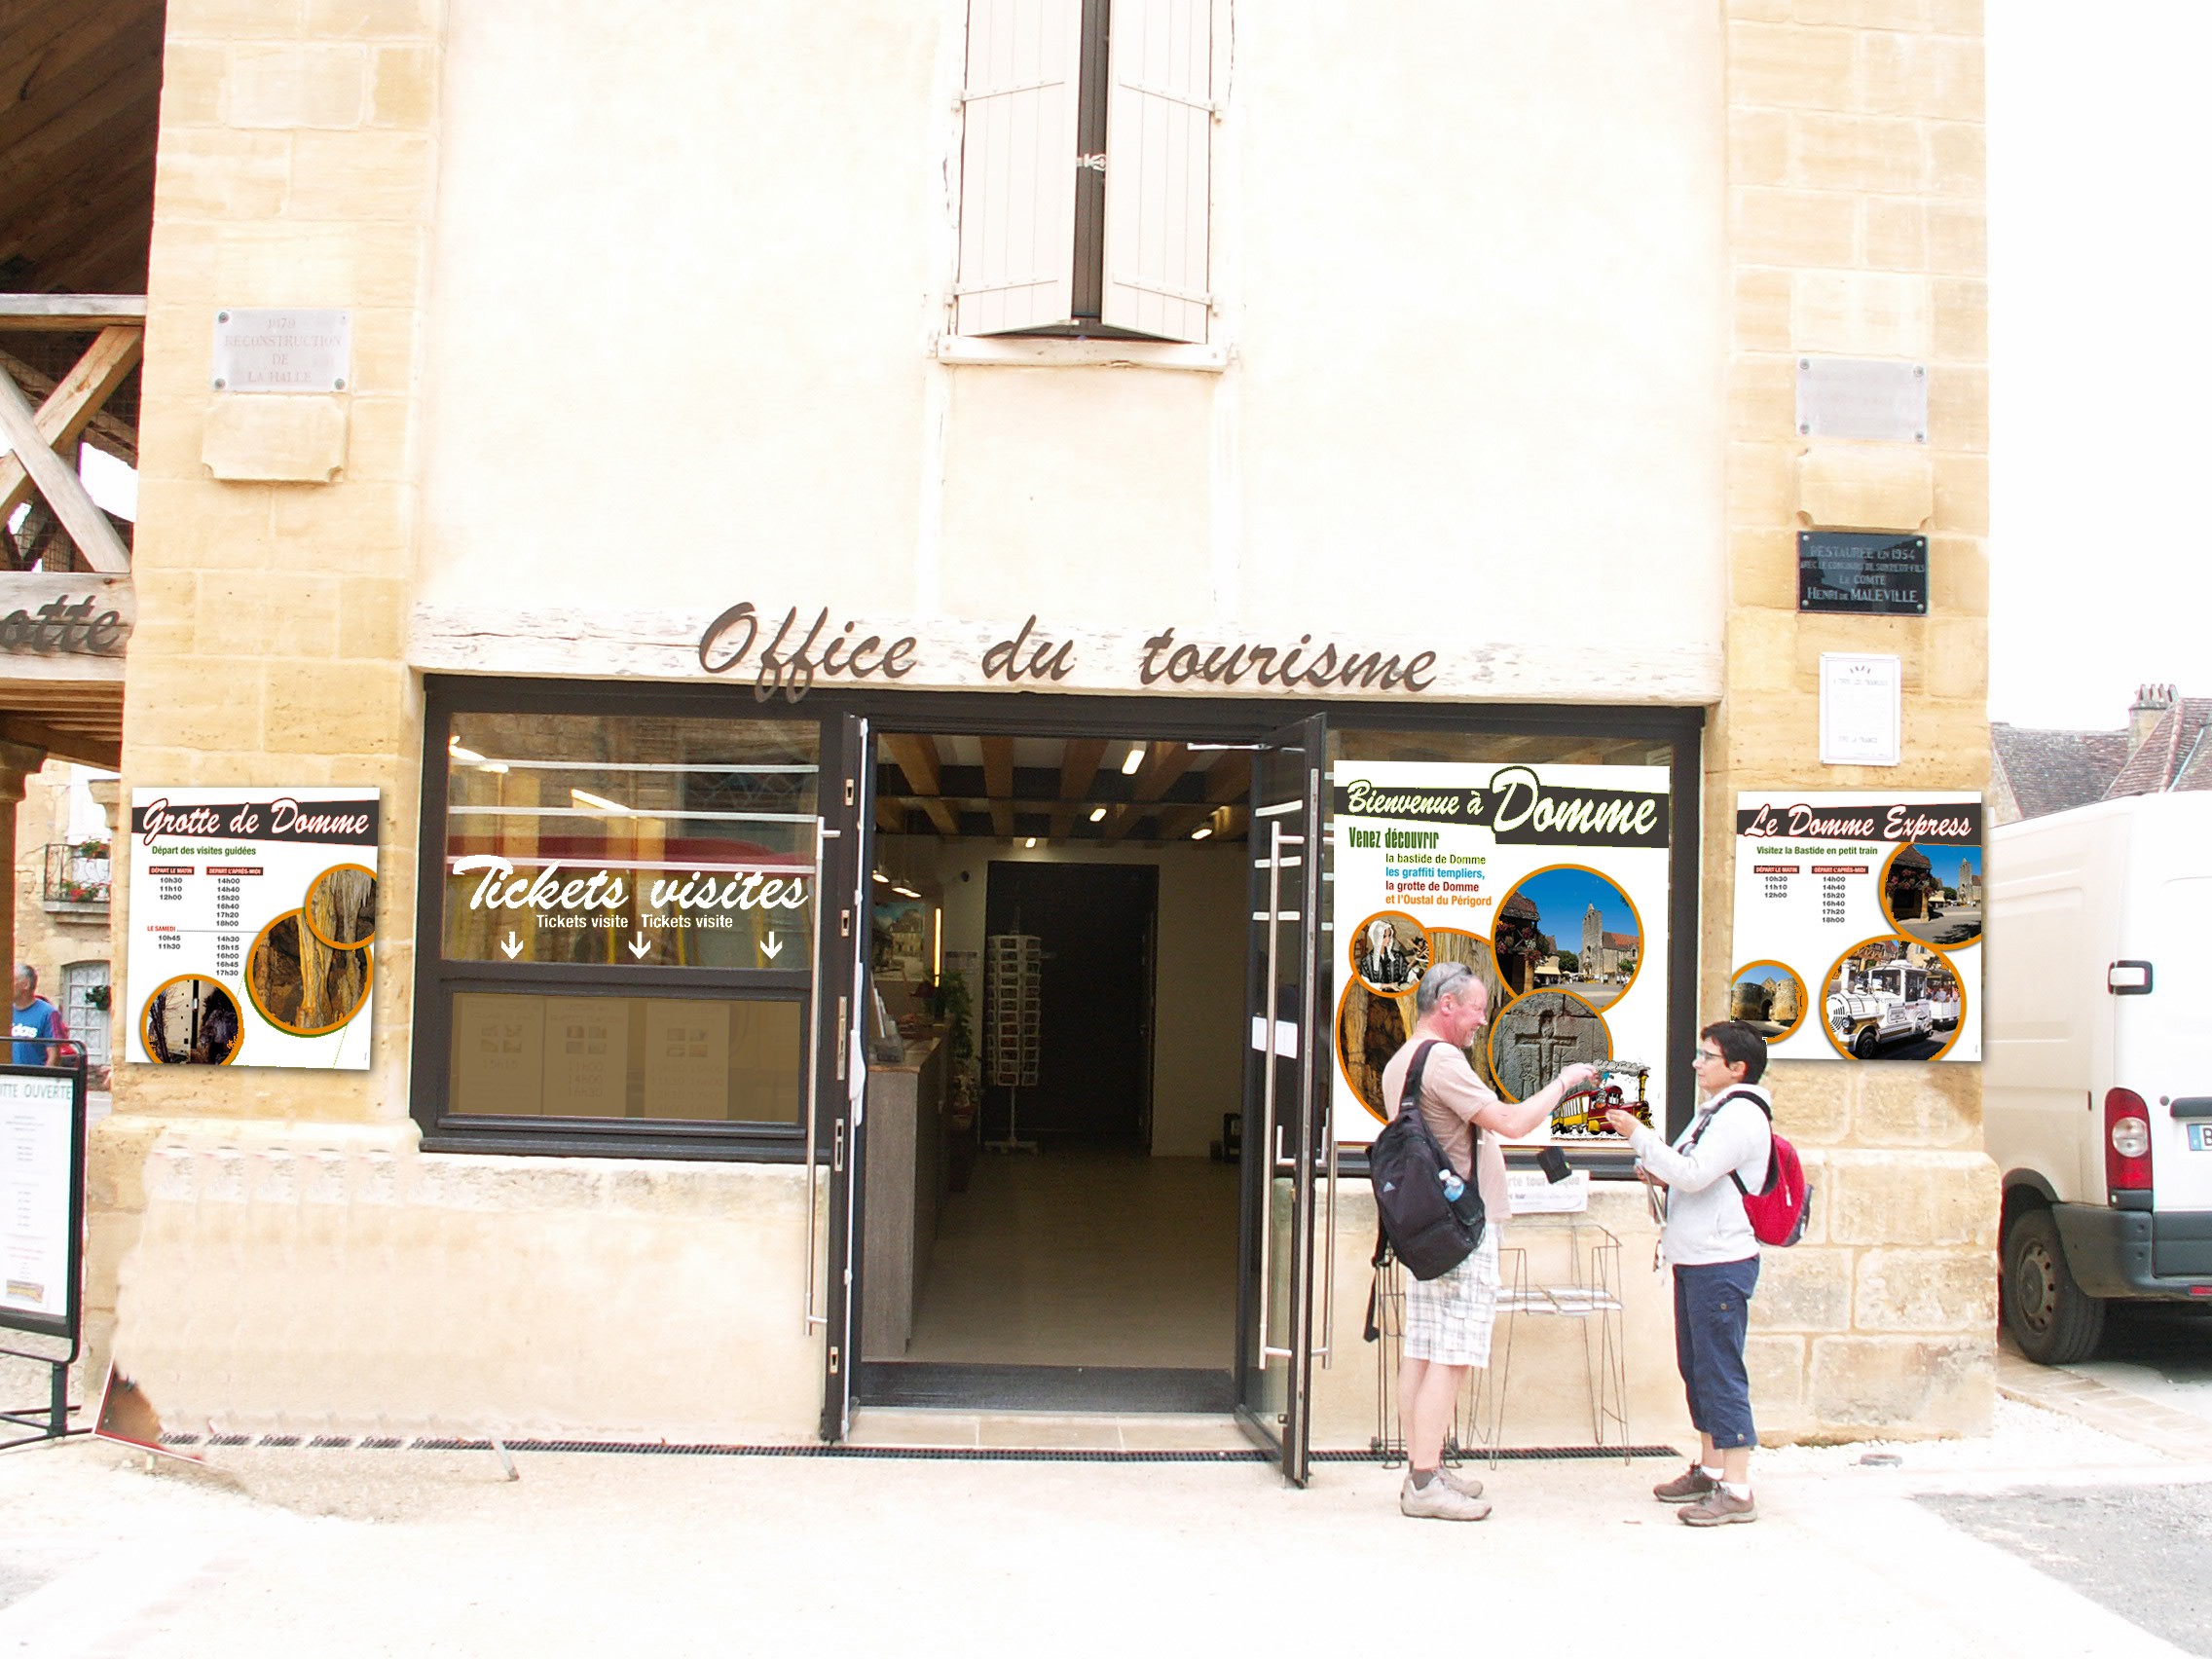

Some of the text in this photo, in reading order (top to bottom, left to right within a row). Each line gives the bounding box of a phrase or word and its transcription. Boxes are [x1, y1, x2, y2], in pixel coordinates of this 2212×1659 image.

[272, 353, 289, 366] DE
[247, 371, 264, 383] LA
[1850, 588, 1918, 604] MALEVILLE
[698, 602, 1438, 704] Office du tourisme
[1347, 766, 1658, 835] Bienvenue à Domme
[142, 798, 370, 846] Grotte de Domme
[1745, 804, 1972, 843] Le Domme Express
[1348, 827, 1440, 849] Venez découvrir
[152, 845, 257, 857] Départ des visites guidées
[1756, 846, 1783, 855] Visitez
[1785, 846, 1792, 855] la
[1794, 846, 1825, 855] Bastide
[1838, 846, 1857, 856] petit
[1859, 846, 1878, 855] train
[1385, 853, 1487, 865] la bastide de Domme
[1385, 866, 1486, 880] les graffiti templiers,
[452, 854, 809, 912] Tickets visites
[1385, 880, 1480, 893] la grotte de Domme
[1385, 894, 1492, 907] et l'Oustal du Périgord
[536, 914, 733, 929] Tickets visite Tickets visite
[24, 1083, 71, 1100] OUVERTE
